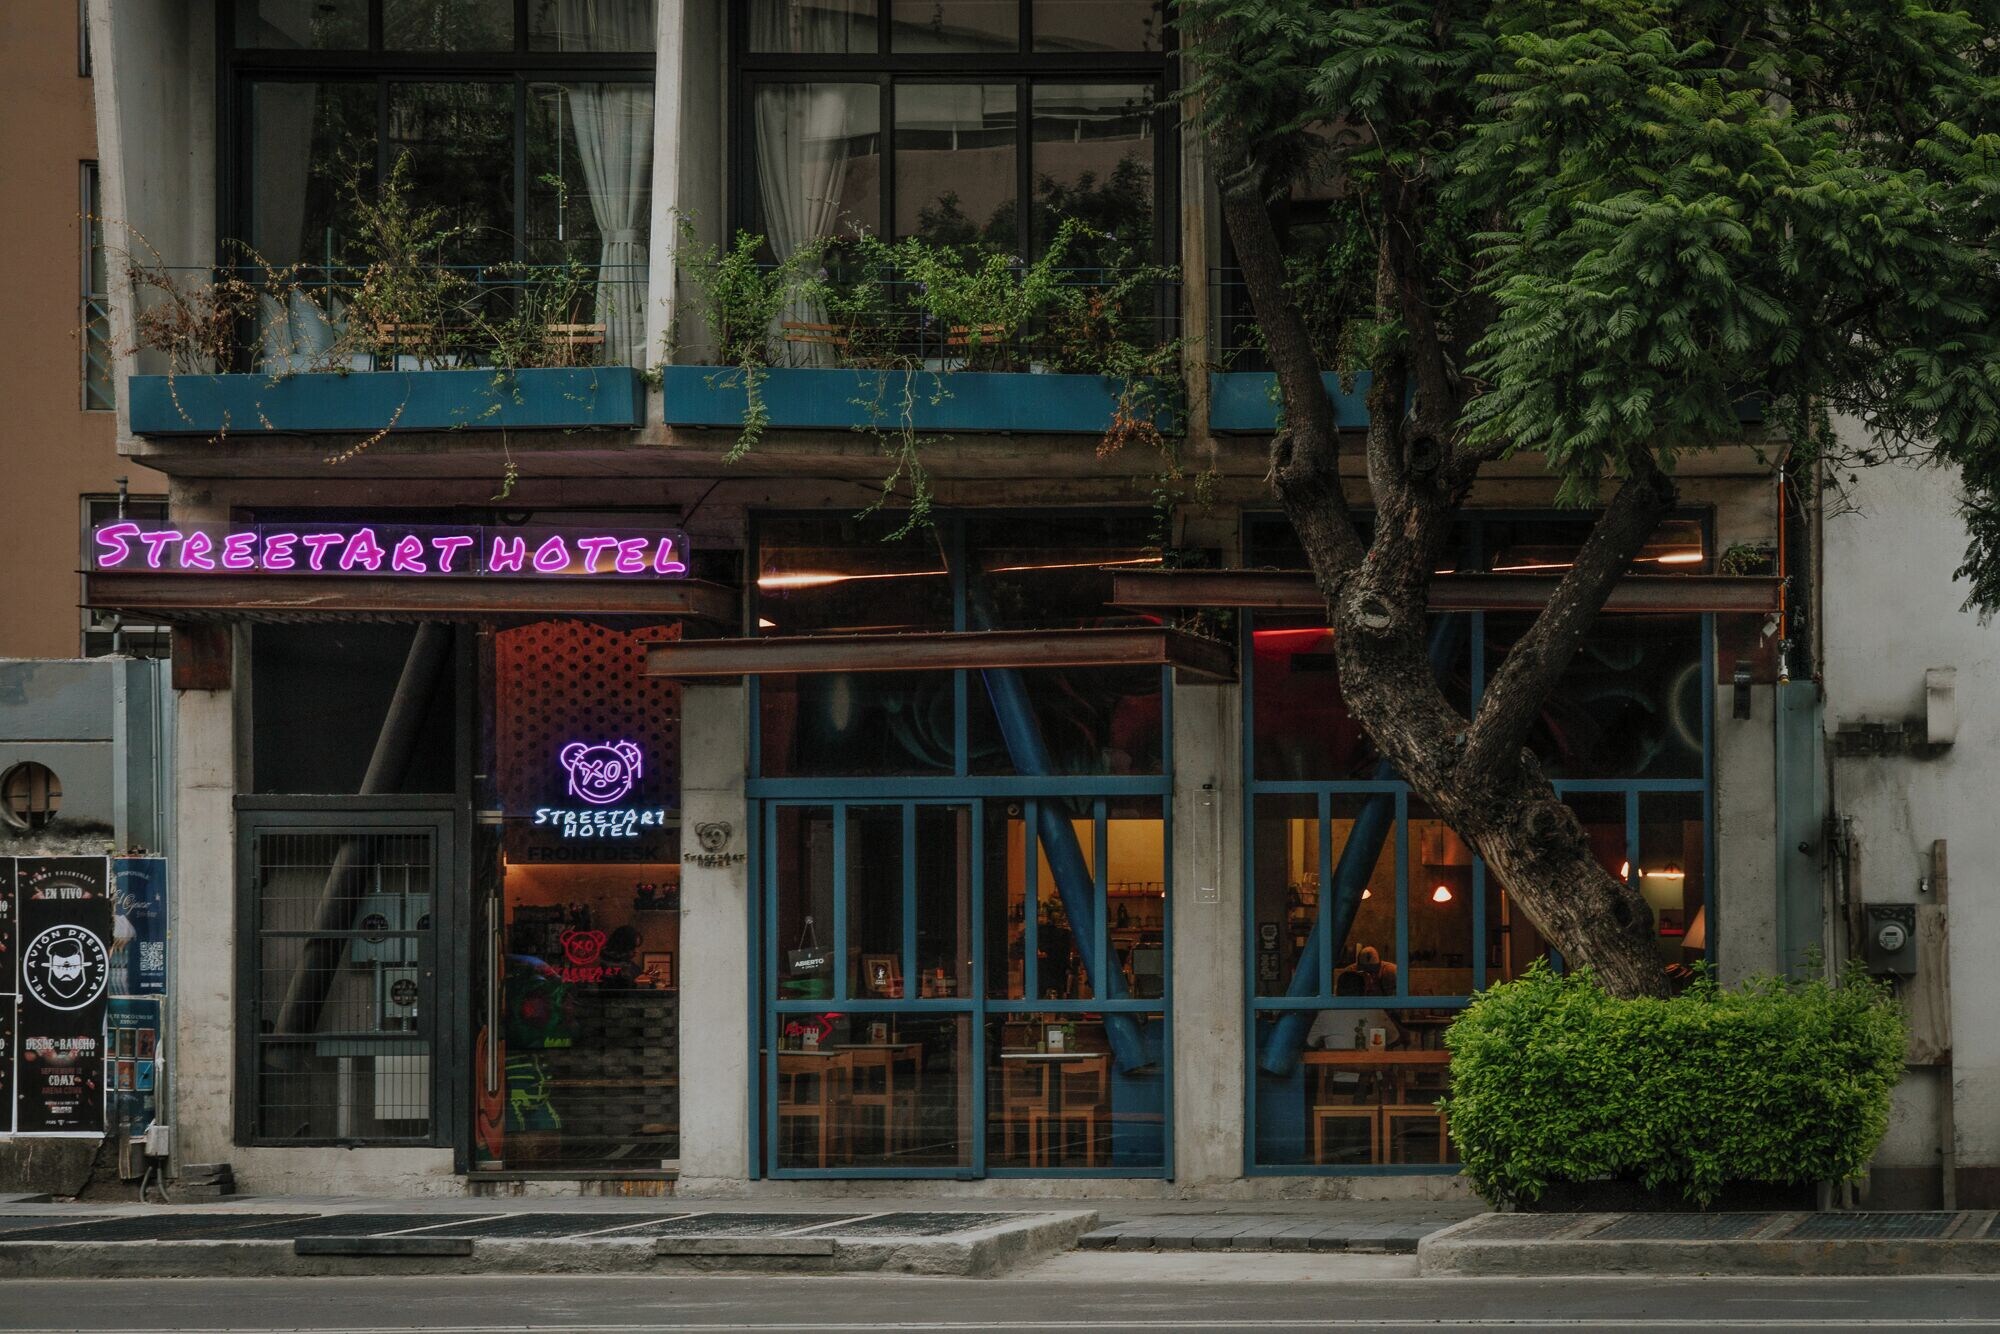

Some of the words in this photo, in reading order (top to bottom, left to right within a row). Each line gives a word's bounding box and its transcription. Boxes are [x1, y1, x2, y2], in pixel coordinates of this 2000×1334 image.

[96, 523, 474, 573] STREETART
[489, 535, 686, 574] HOTEL
[534, 808, 665, 825] STREETART
[563, 822, 639, 838] HOTEL
[527, 846, 599, 861] FRONT
[604, 846, 657, 861] DESK
[44, 888, 57, 900] EN
[60, 887, 83, 900] VIVO
[794, 958, 824, 968] ABIERTO
[25, 1038, 55, 1050] DESDE
[60, 1038, 95, 1050] RANCHO
[48, 1075, 75, 1086] CDMX
